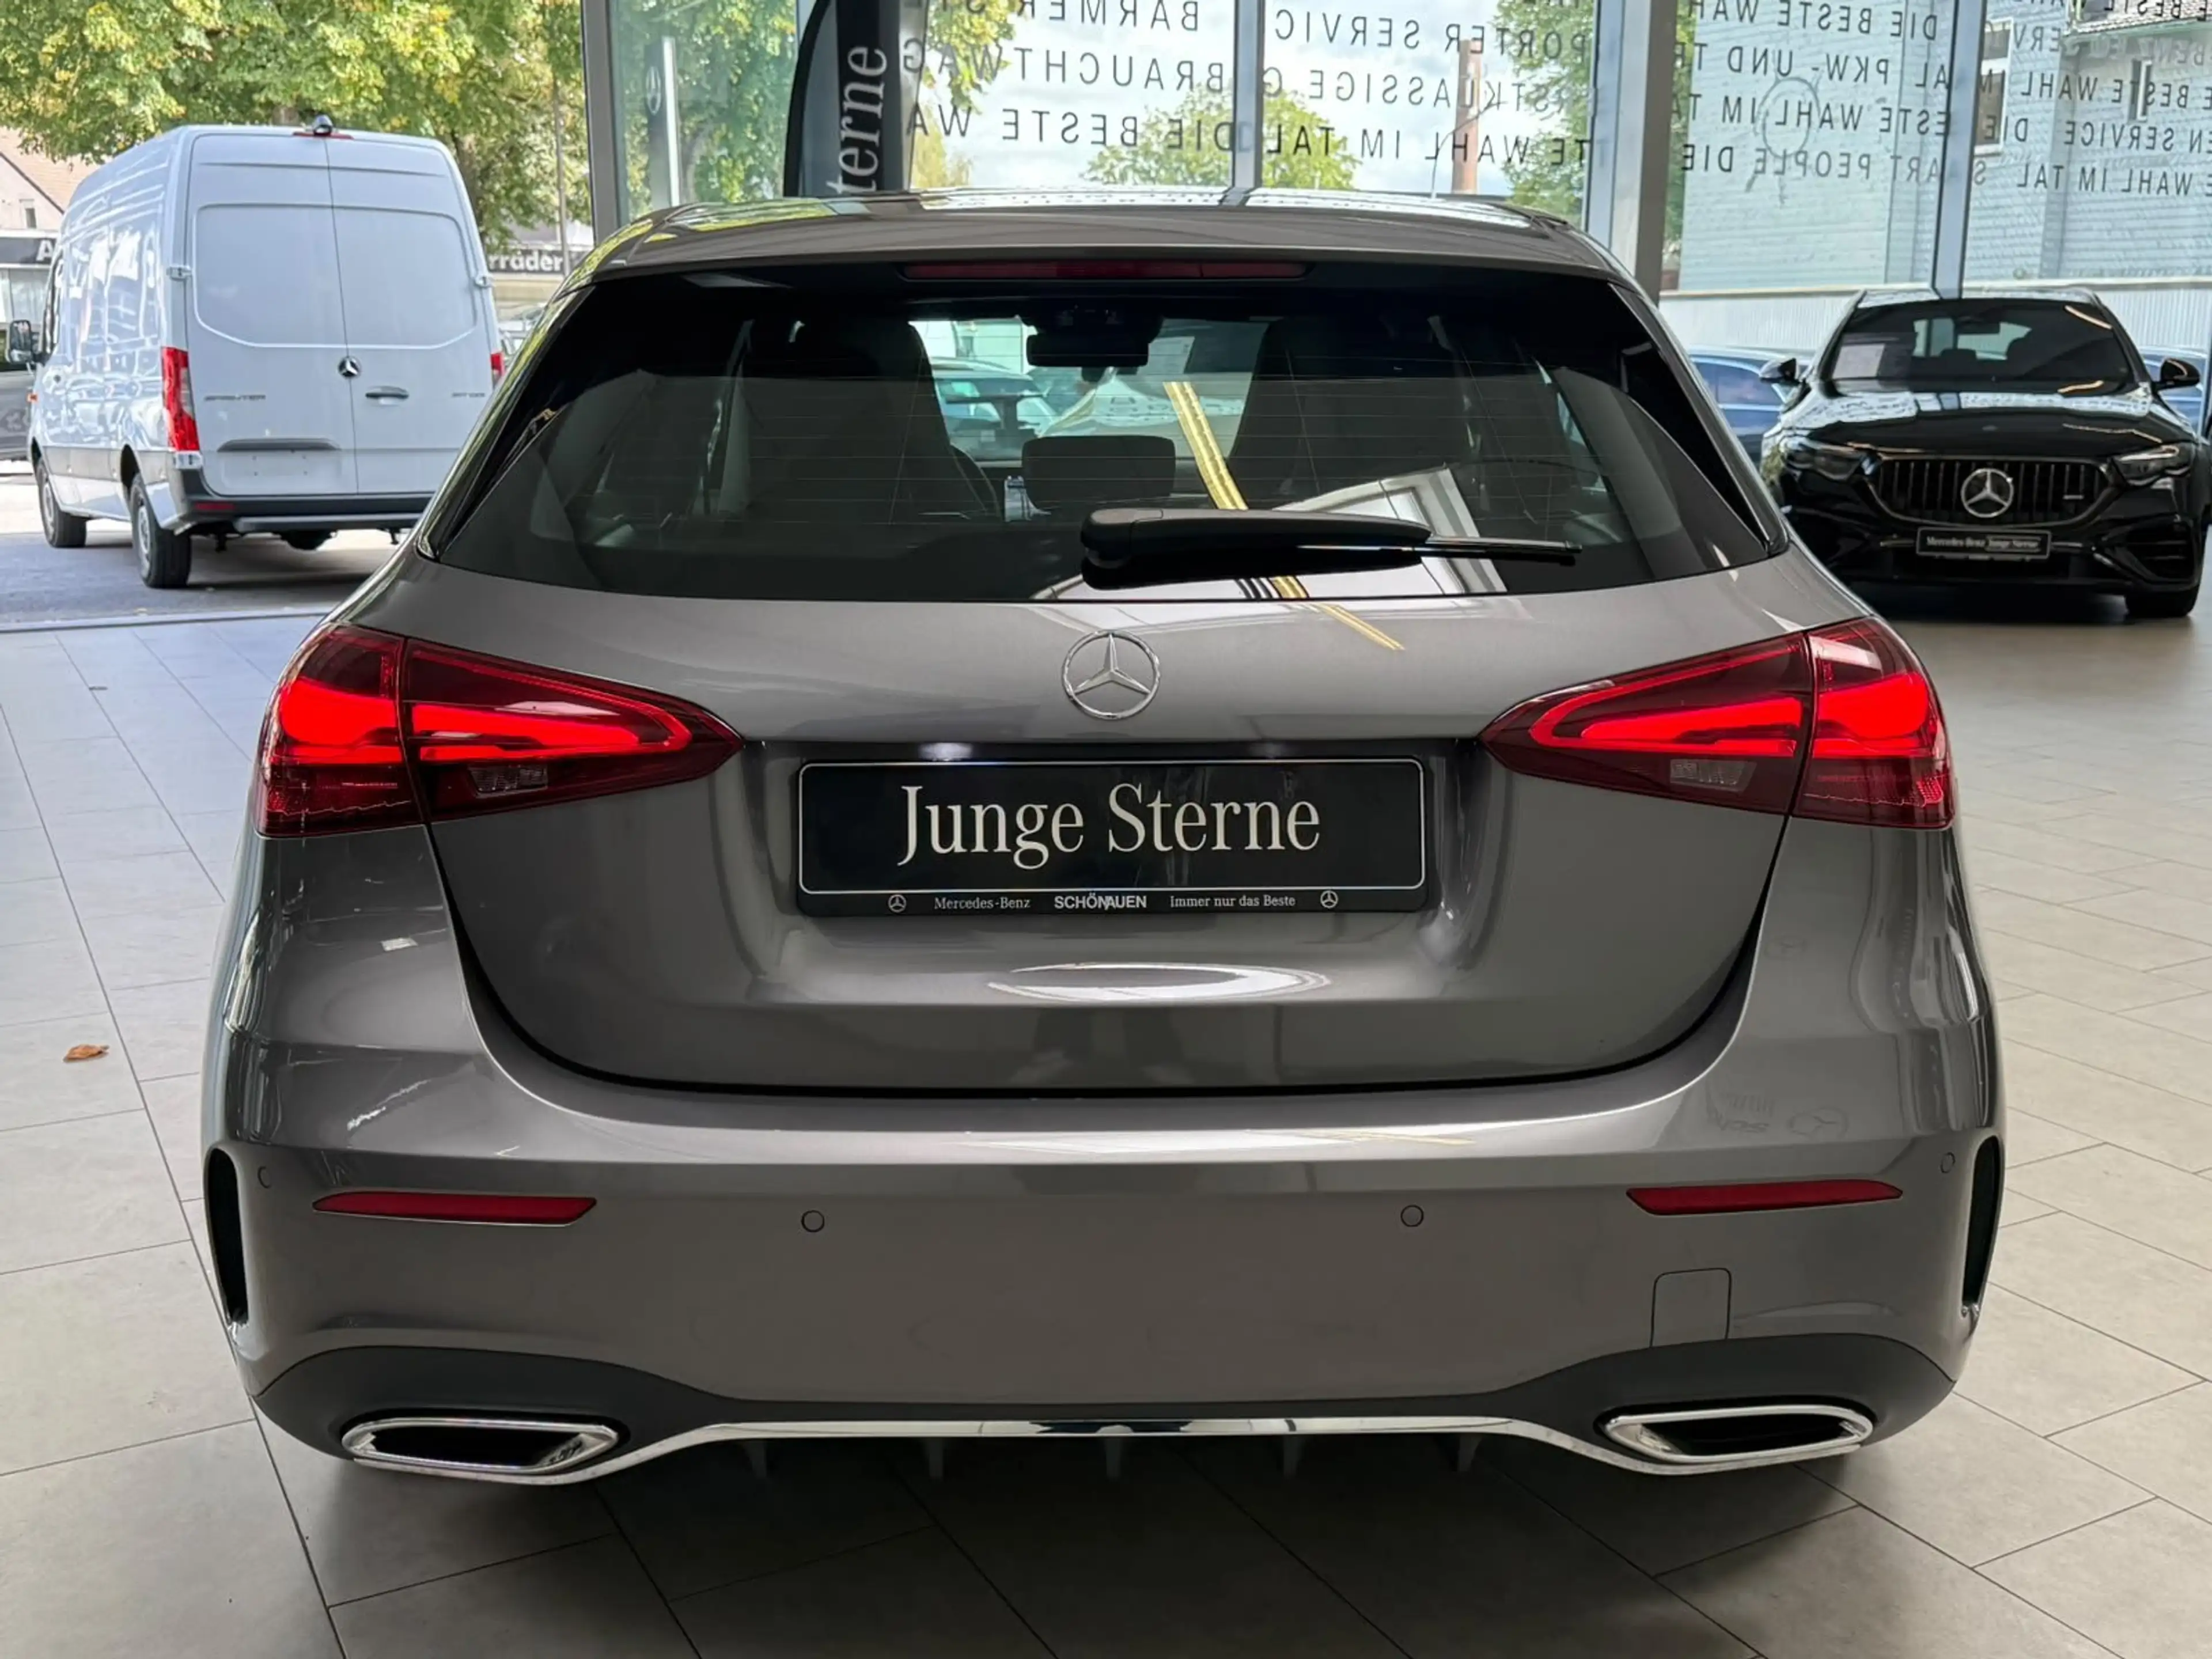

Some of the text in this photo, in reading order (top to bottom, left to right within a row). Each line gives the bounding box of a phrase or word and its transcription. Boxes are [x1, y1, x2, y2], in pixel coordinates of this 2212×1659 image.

[897, 783, 1320, 869] Junge Sterne
[934, 892, 1296, 910] Mercedes-Benz SCHÖNAUEN Immer nur das Beste
